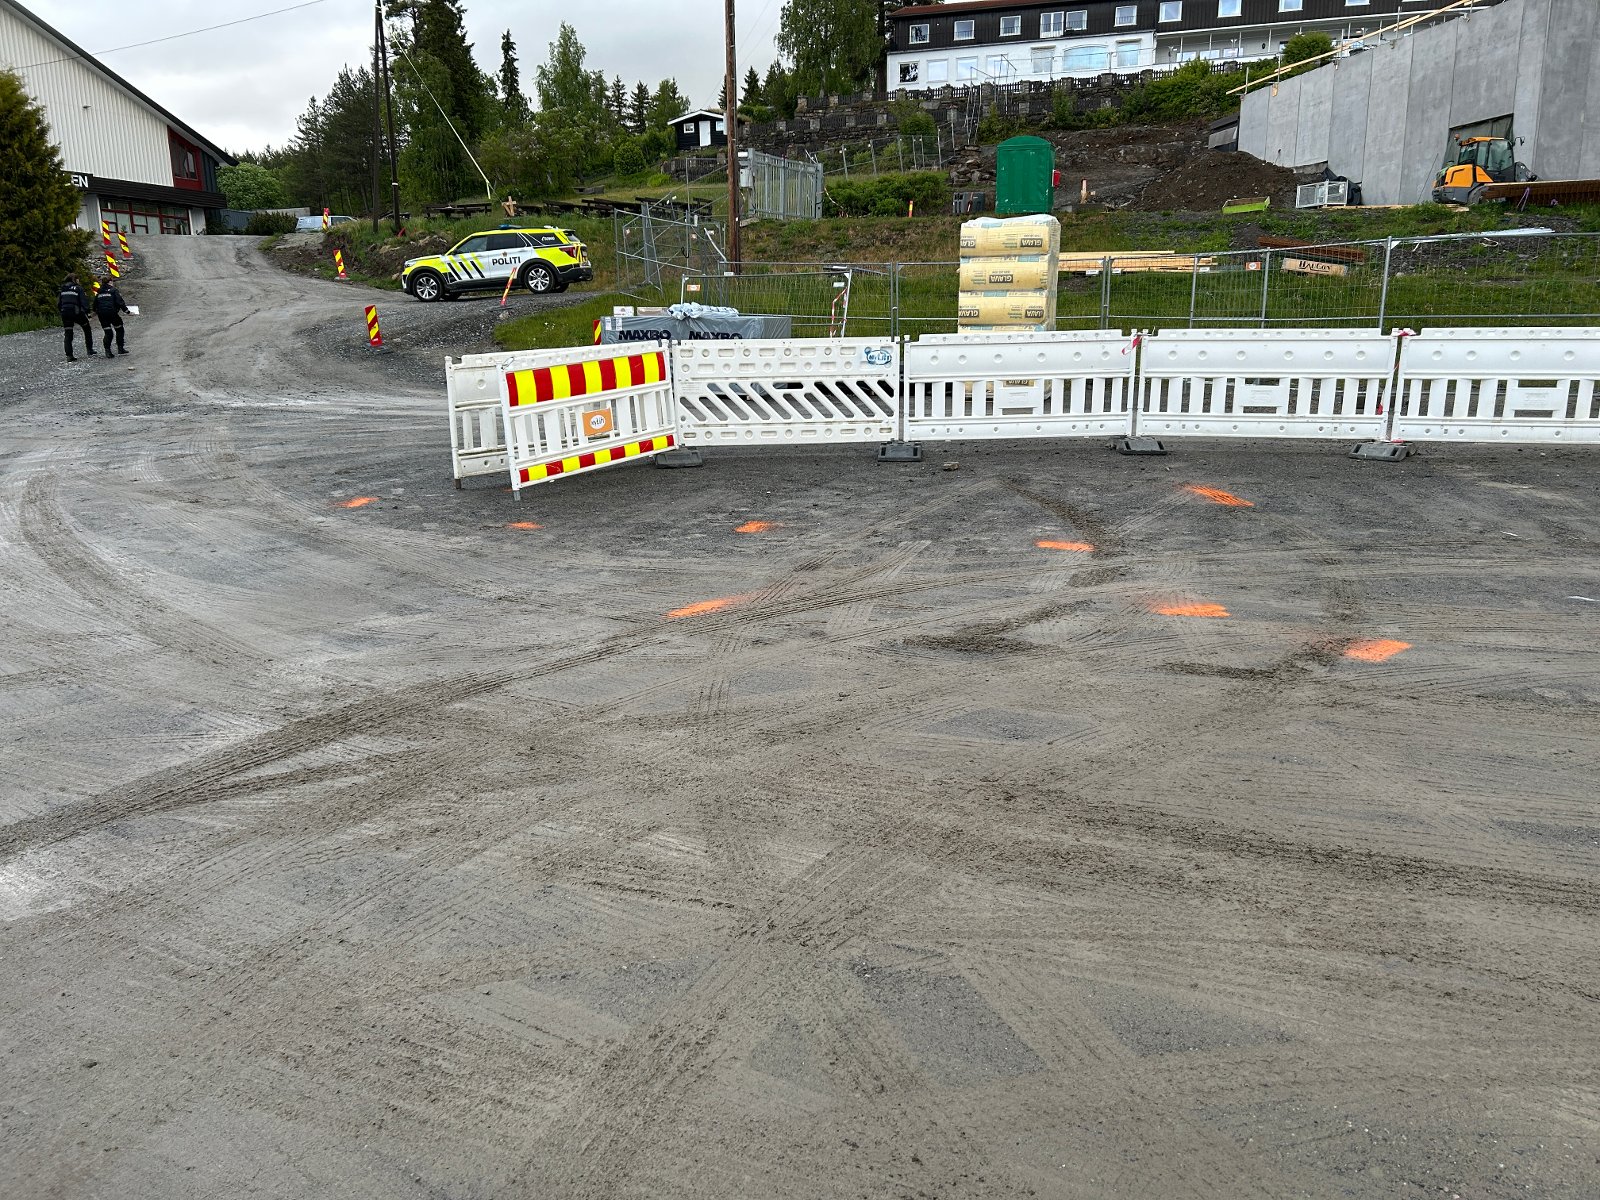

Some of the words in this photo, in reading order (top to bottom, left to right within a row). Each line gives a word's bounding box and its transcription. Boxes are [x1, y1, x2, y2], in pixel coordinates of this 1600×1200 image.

[65, 174, 89, 189] EN
[1021, 239, 1042, 247] GLAVA
[492, 256, 521, 266] POLITI
[618, 329, 671, 340] MAXBO
